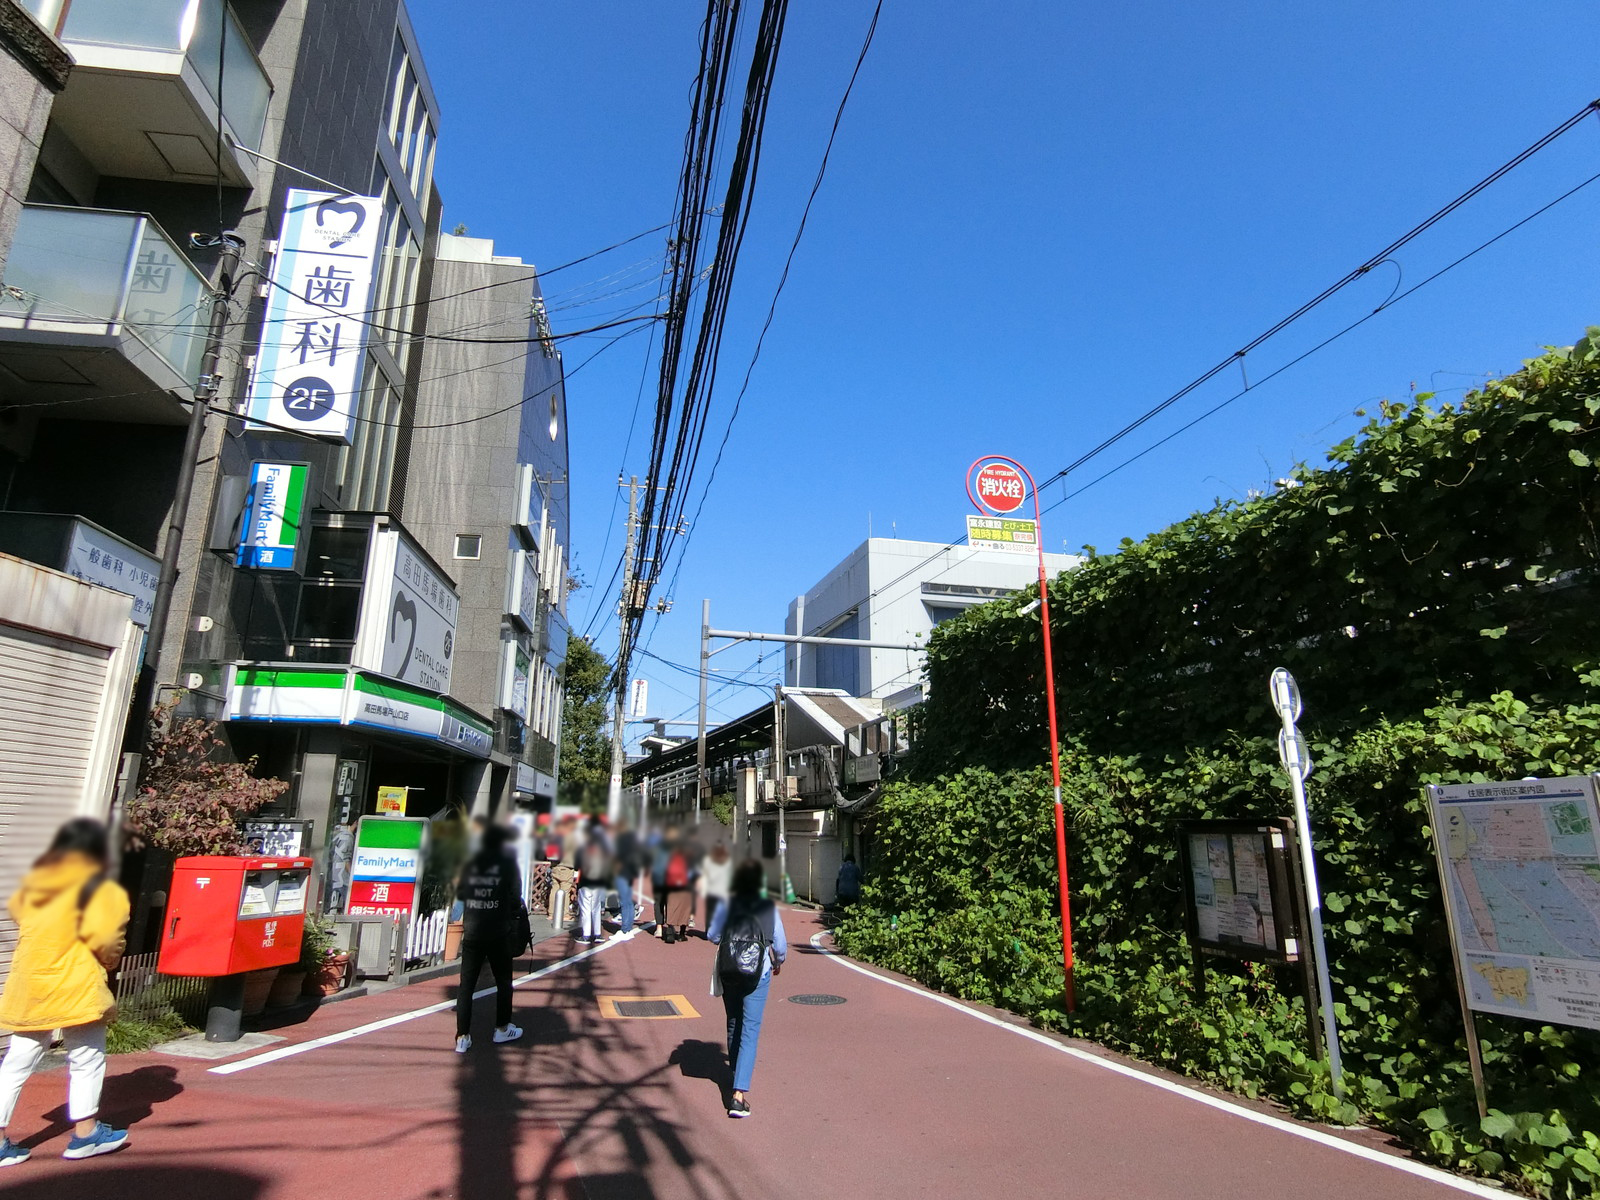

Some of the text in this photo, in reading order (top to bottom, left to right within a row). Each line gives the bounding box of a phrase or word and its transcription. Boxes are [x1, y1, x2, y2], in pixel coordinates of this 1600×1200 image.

[315, 229, 340, 237] DENTAL
[290, 265, 355, 367] 歯科
[288, 387, 329, 410] 2F
[981, 478, 1022, 498] 消火栓
[255, 468, 281, 541] FamilyMart
[77, 546, 124, 576] 一般歯科
[260, 550, 275, 563] 酒
[402, 553, 452, 616] 高田馬場歯科
[414, 646, 448, 680] DENTAL CARE
[419, 670, 441, 691] STATION
[1467, 784, 1546, 798] 住居表示街区案内図
[357, 855, 415, 870] FamilyMart
[370, 883, 390, 902] 酒
[474, 888, 493, 897] NOT
[466, 899, 499, 909] FRIENDS
[262, 939, 276, 948] POST
